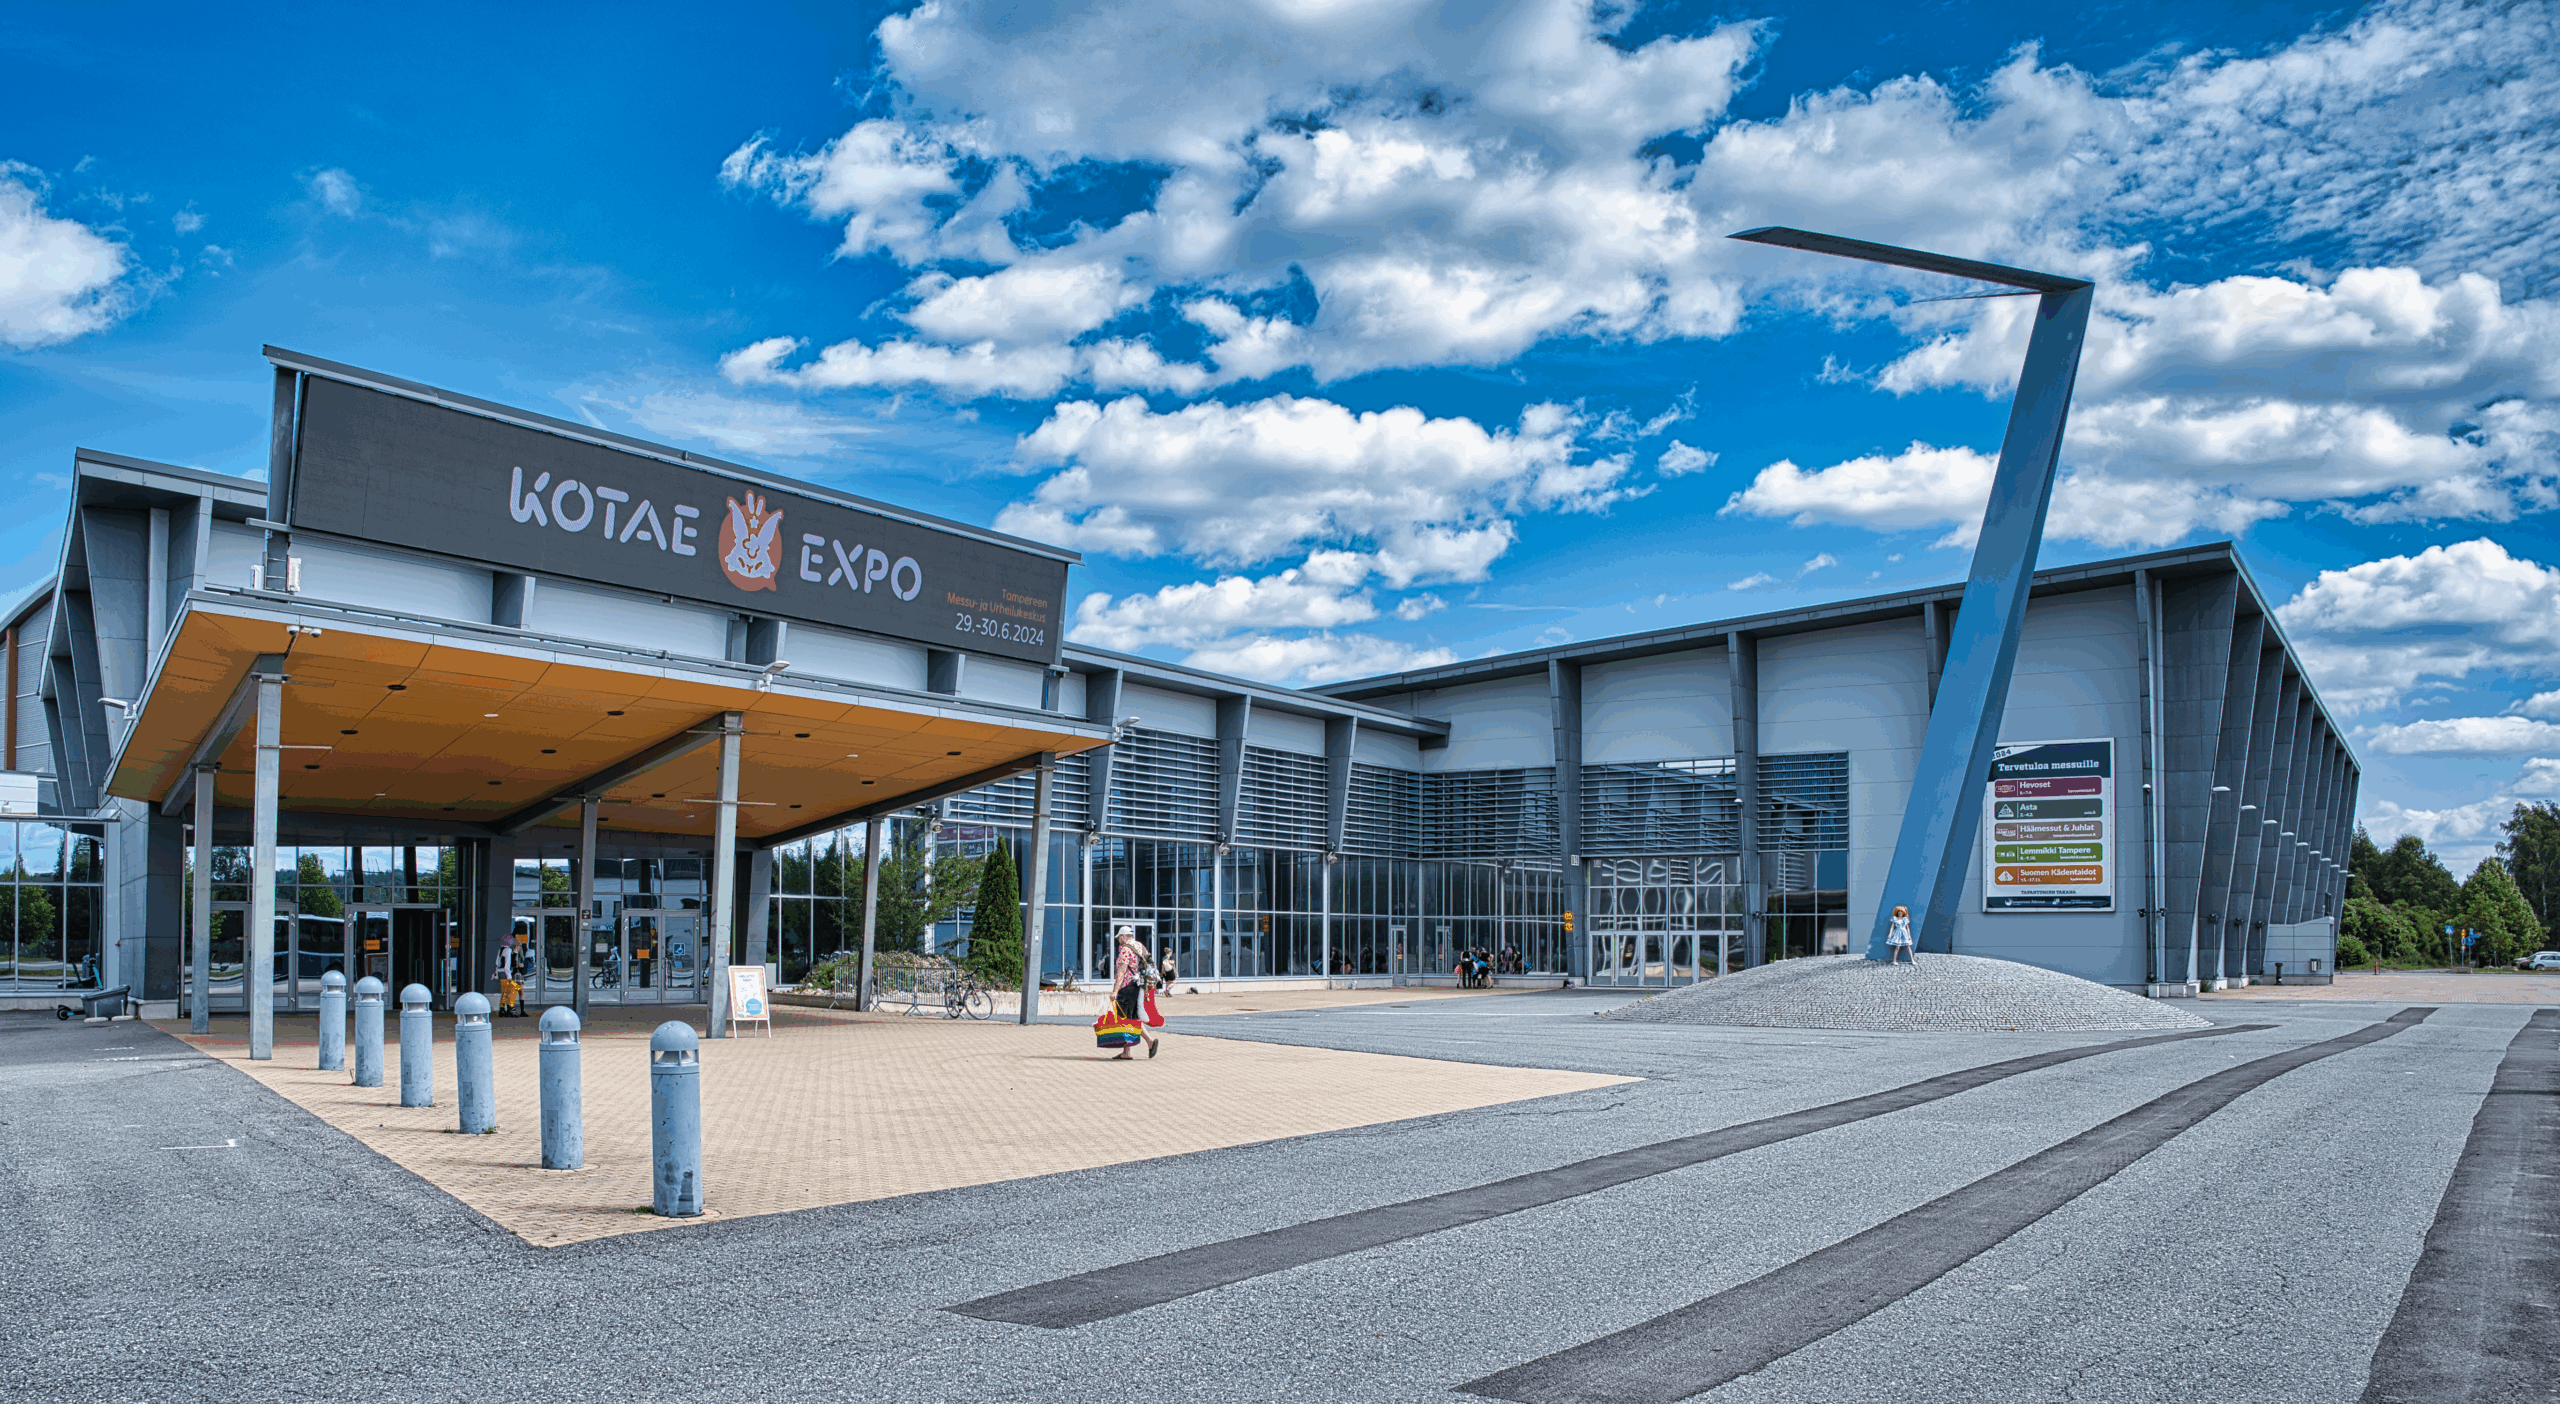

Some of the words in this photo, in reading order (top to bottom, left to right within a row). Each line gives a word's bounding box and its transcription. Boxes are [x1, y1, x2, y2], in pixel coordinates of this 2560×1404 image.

[510, 466, 700, 556] KOTAE
[800, 533, 922, 601] EXPO
[1002, 588, 1048, 609] Tampereen
[947, 591, 979, 608] Messu-
[979, 598, 988, 612] ja
[990, 600, 1046, 623] Urheilukeskus
[955, 612, 1044, 647] 29.-30.6.2024
[1997, 762, 2049, 772] Tervetuloa
[2051, 759, 2099, 770] messuille
[2019, 780, 2052, 789] Hevoset
[2020, 803, 2038, 811] Asta
[2020, 824, 2062, 833] Häämessut
[2063, 823, 2070, 832] &
[2071, 823, 2095, 832] Juhlat
[2020, 846, 2057, 855] Lemmikki
[2059, 846, 2092, 855] Tampere
[2020, 869, 2050, 877] Suomen
[2051, 868, 2097, 876] Kädentaidot
